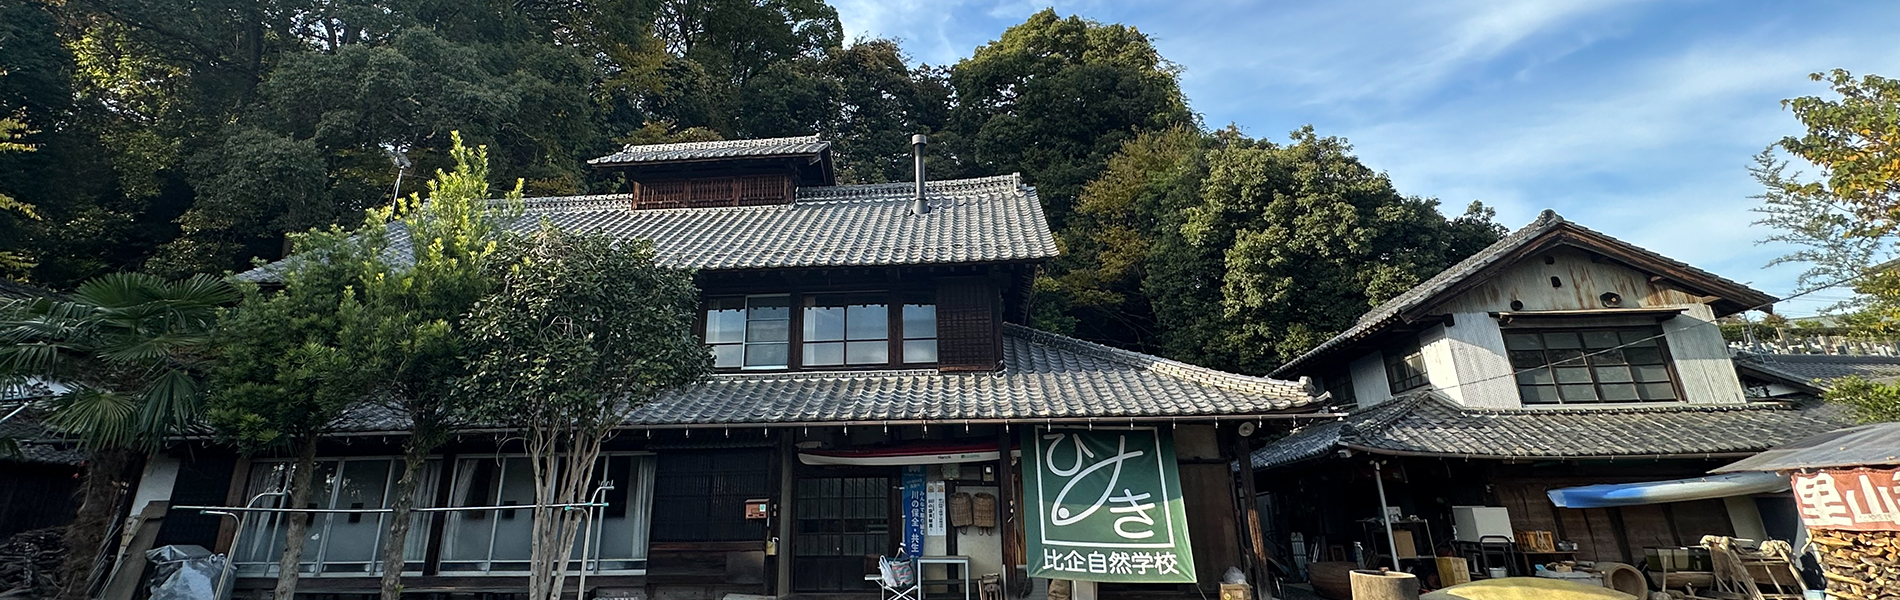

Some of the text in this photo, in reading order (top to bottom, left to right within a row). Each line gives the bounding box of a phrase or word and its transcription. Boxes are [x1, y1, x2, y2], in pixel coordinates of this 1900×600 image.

[911, 490, 920, 553] 川の保全・共生
[1795, 472, 1900, 526] 里山
[1042, 548, 1180, 575] 比企自然学校
